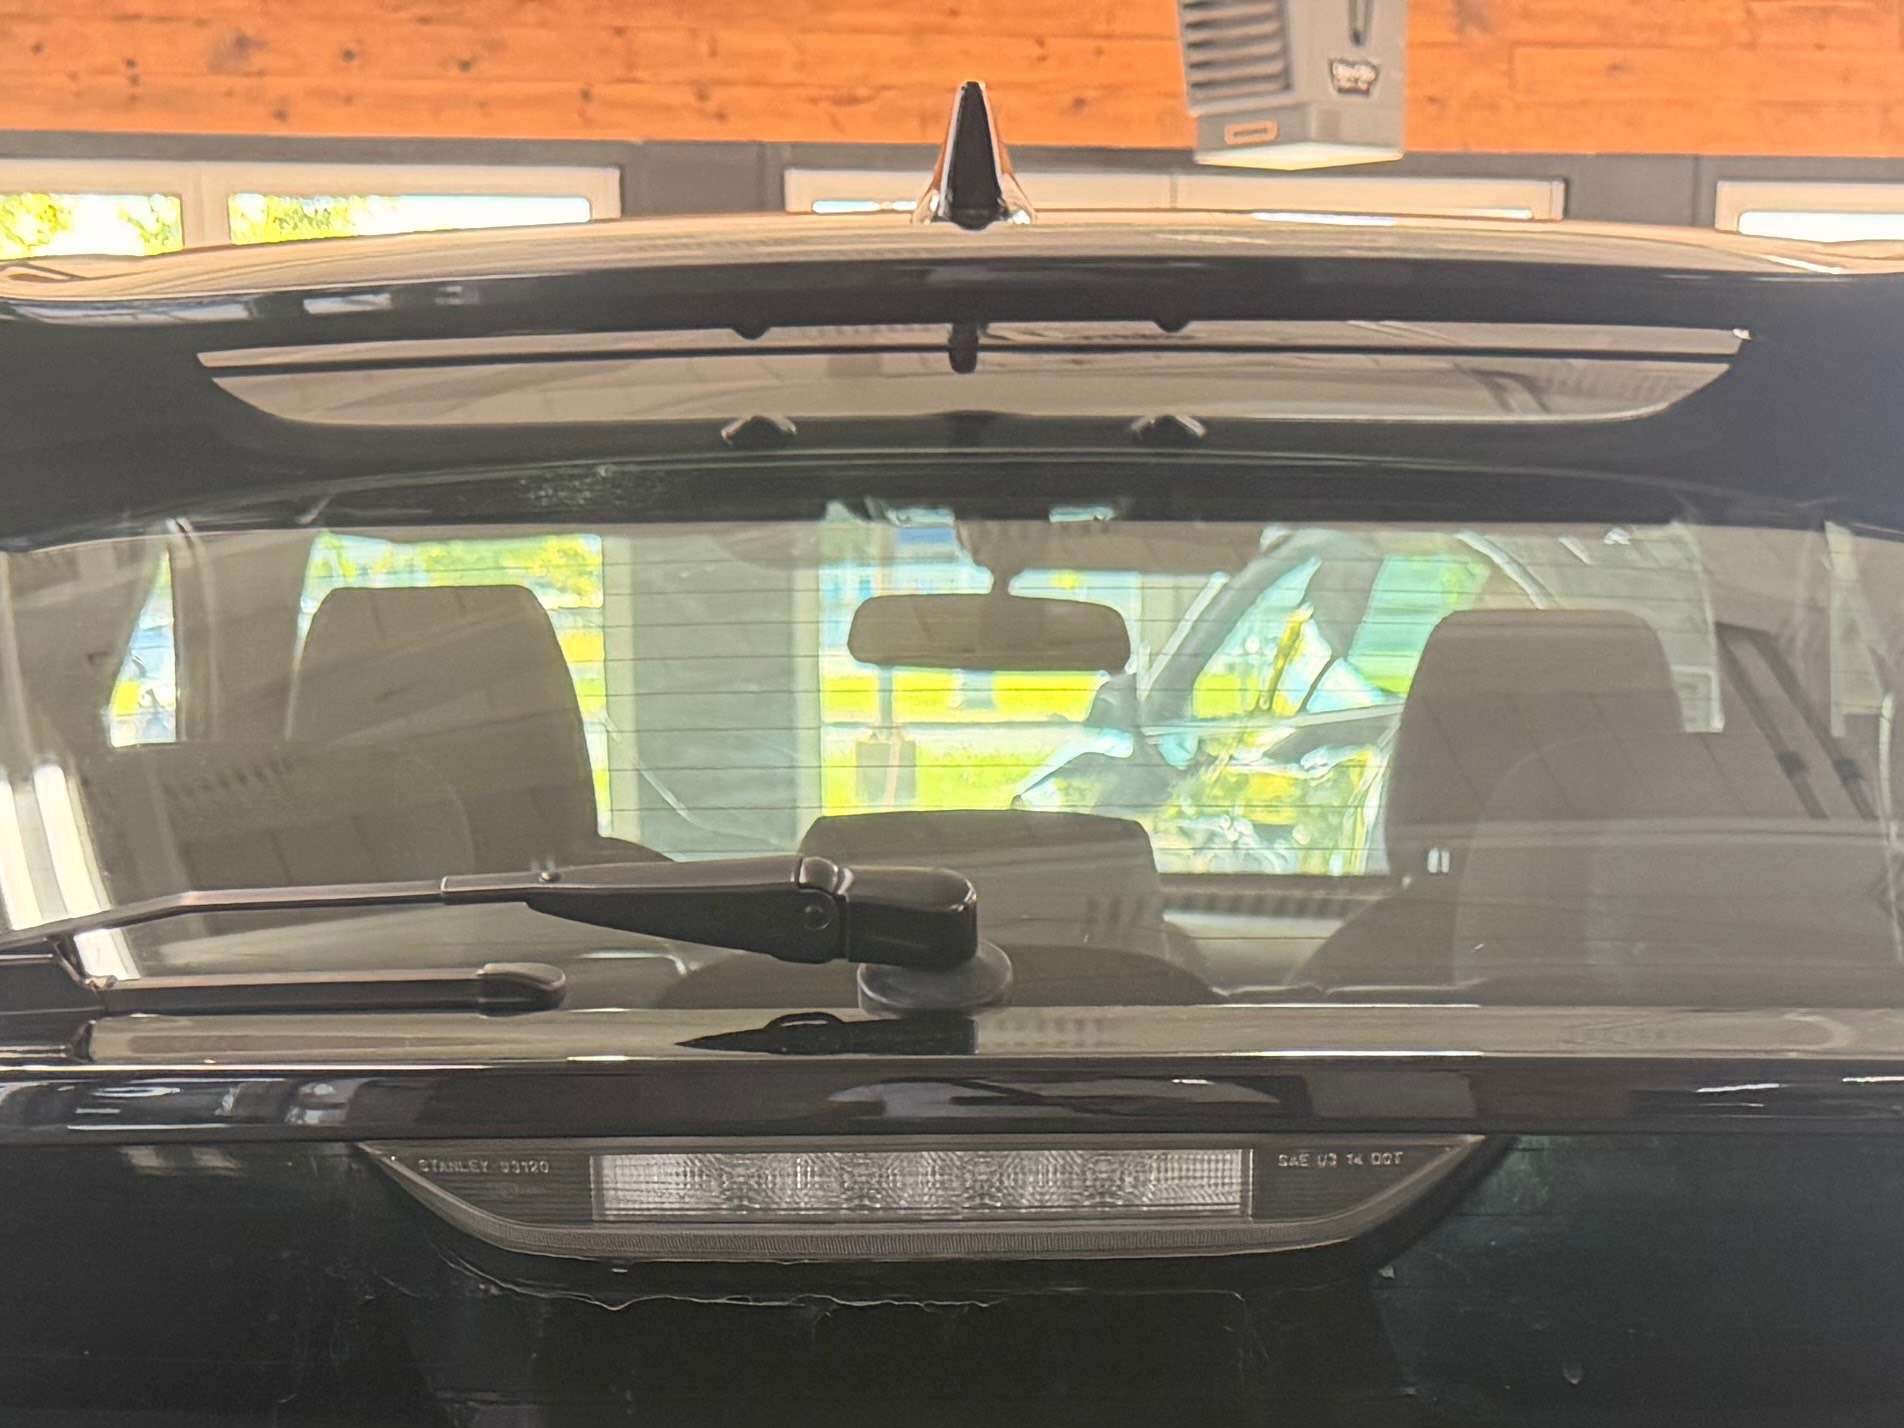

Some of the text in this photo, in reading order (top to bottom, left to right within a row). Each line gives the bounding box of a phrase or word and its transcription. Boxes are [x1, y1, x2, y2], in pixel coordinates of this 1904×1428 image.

[418, 1159, 488, 1173] STANLEY
[1278, 1153, 1310, 1168] SAE
[1371, 1151, 1405, 1166] DOT
